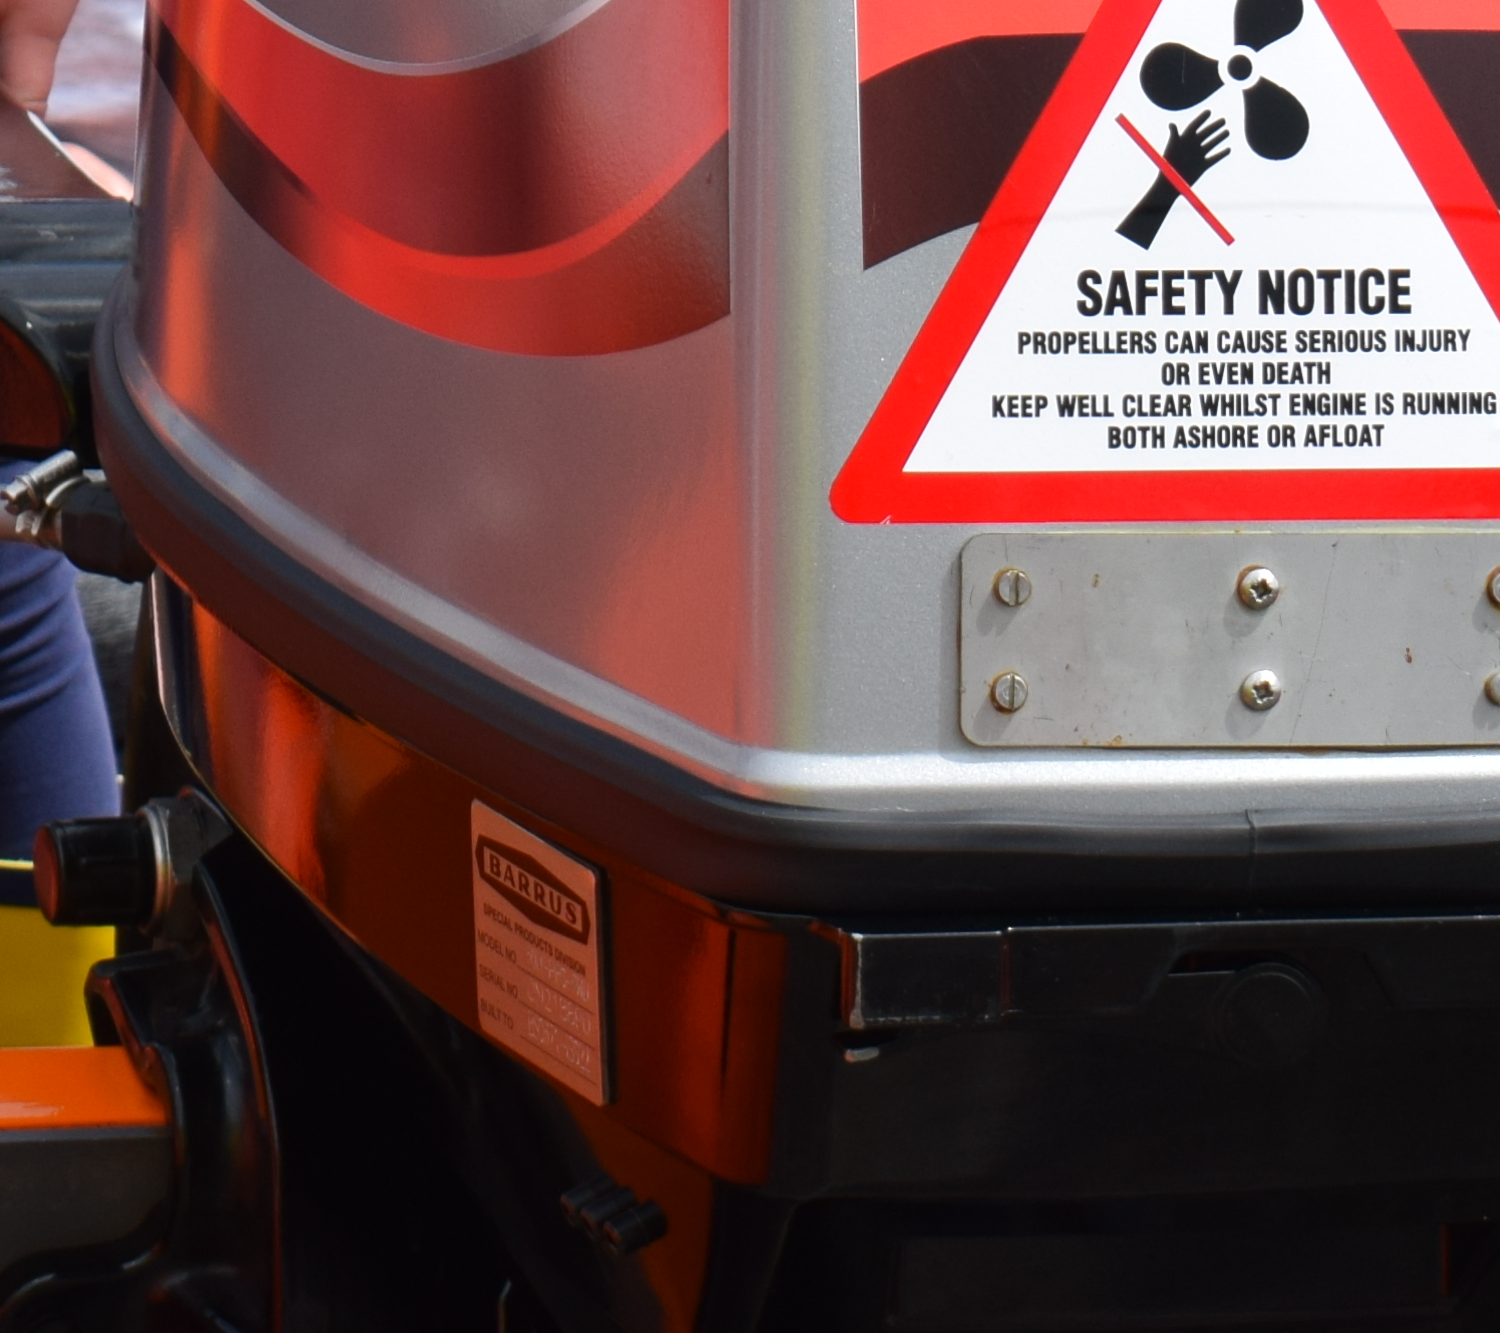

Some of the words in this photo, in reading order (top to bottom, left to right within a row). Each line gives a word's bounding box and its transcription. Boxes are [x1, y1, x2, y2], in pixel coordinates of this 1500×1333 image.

[1076, 268, 1243, 317] SAFETY
[1257, 267, 1412, 316] NOTICE
[1017, 330, 1157, 355] PROPELLERS
[1164, 330, 1209, 354] CAN
[1216, 329, 1288, 353] CAUSE
[1294, 329, 1387, 353] SERIOUS
[1394, 328, 1471, 352] INJURY
[1161, 362, 1190, 385] OR
[1198, 361, 1254, 385] EVEN
[1262, 361, 1331, 385] DEATH
[991, 394, 1048, 418] KEEP
[1056, 394, 1114, 418] WELL
[1122, 394, 1192, 418] CLEAR
[1200, 393, 1281, 417] WHILST
[1289, 392, 1367, 416] ENGINE
[1375, 392, 1394, 415] IS
[1402, 391, 1498, 415] RUNNING
[1107, 425, 1166, 449] BOTH
[1172, 425, 1260, 448] ASHORE
[1266, 424, 1296, 448] OR
[1303, 424, 1385, 448] AFLOAT
[489, 852, 577, 927] BARRUS
[477, 928, 504, 958] MODEL
[504, 948, 517, 965] NO
[483, 902, 513, 932] SPECIAL
[514, 921, 553, 957] PRODUCTS
[554, 947, 586, 977] DIVISION
[479, 963, 504, 991] SERIAL
[505, 980, 518, 1000] NO
[480, 998, 501, 1023] BUILT
